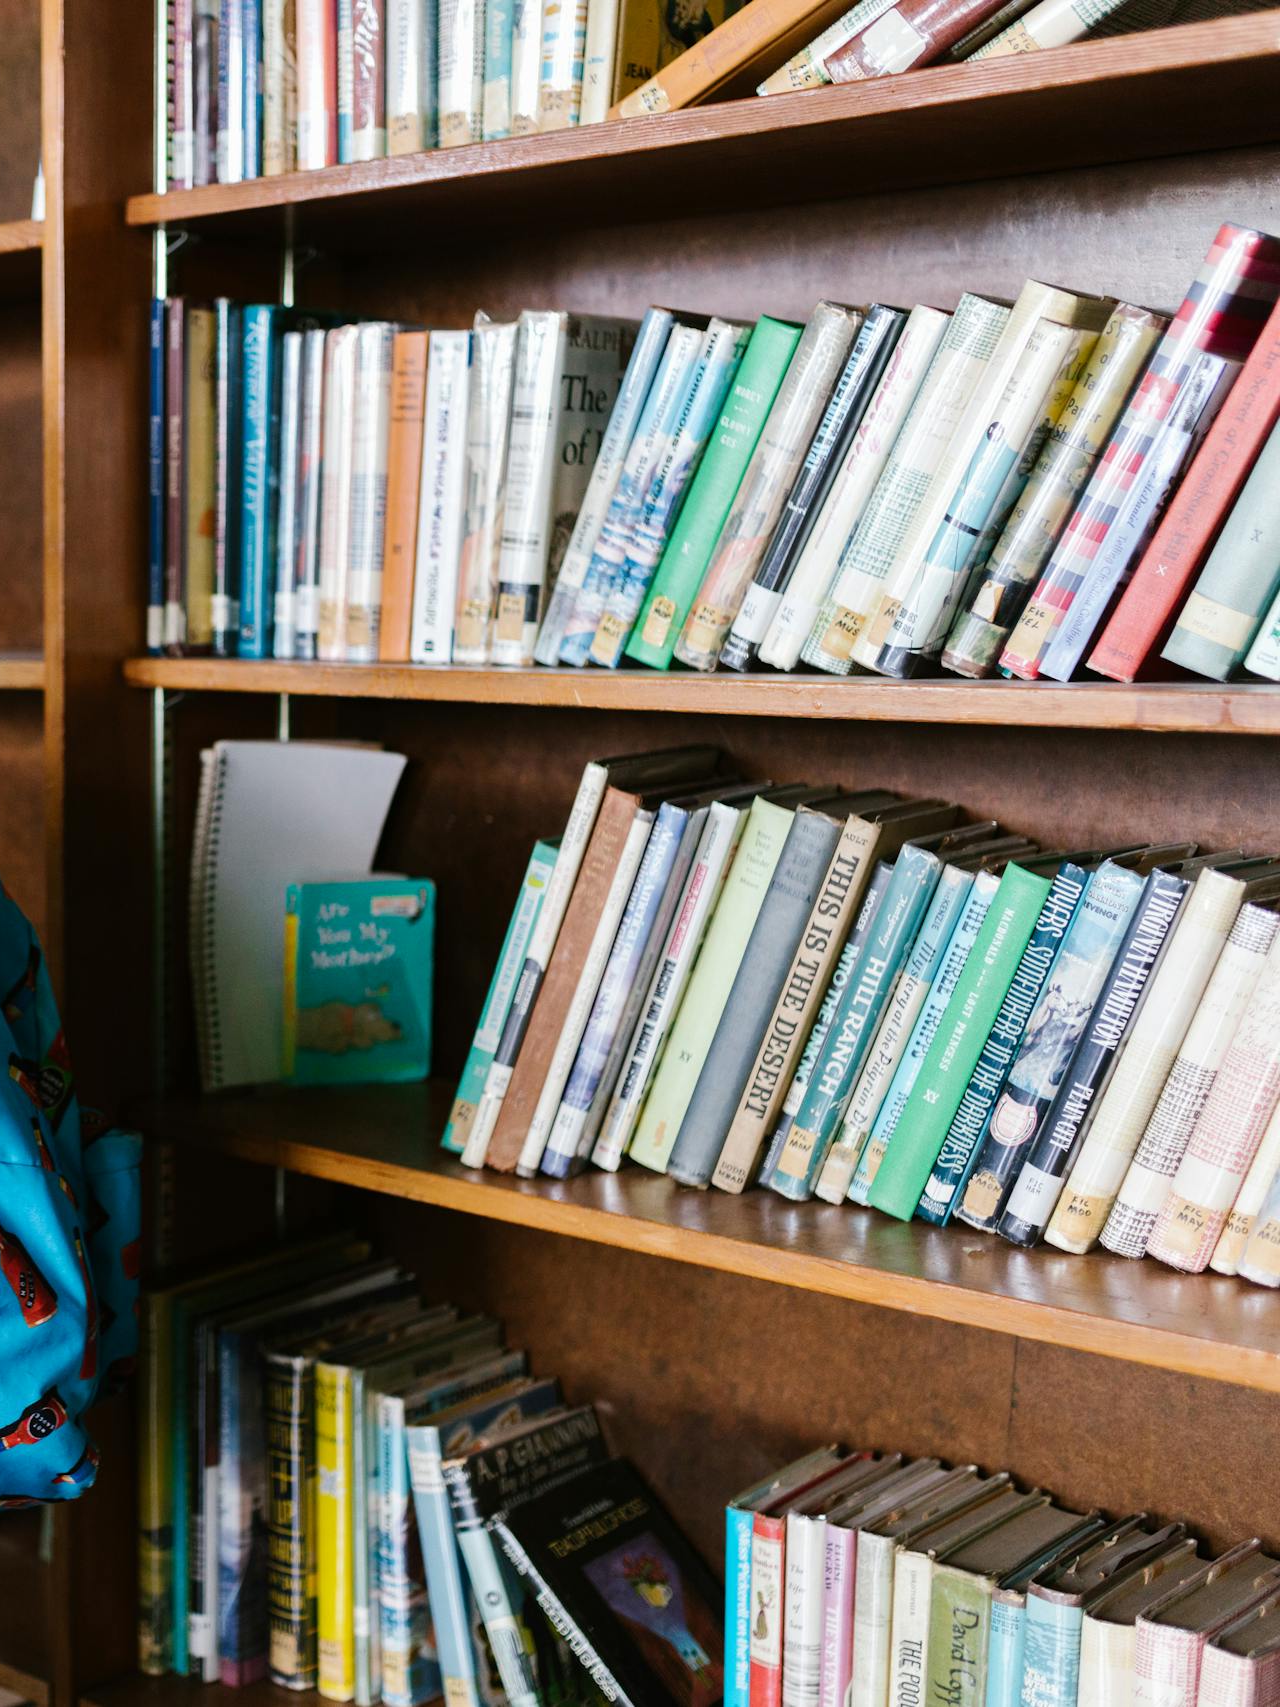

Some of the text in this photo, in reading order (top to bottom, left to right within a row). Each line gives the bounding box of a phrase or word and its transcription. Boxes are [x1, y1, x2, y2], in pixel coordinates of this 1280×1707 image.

[626, 63, 652, 79] JEAN
[703, 329, 719, 359] THE
[561, 374, 608, 413] The
[1232, 371, 1268, 427] Secret
[562, 429, 591, 466] of
[1221, 426, 1241, 447] of
[1123, 479, 1157, 528] McDaniel
[1161, 529, 1188, 563] Hill
[835, 620, 860, 636] MUS
[844, 612, 858, 626] FIC
[1028, 607, 1045, 618] FIC
[843, 831, 869, 847] AULT
[626, 881, 656, 942] America
[854, 887, 879, 933] MOOSER
[961, 897, 990, 936] THE
[1034, 873, 1083, 940] MYERS
[1126, 882, 1183, 968] VIRGINIA
[742, 851, 859, 1121] THIS IS THE DESERT
[935, 939, 973, 998] THREE
[936, 905, 1015, 1073] MACDONALD LOST PRINCESS
[791, 941, 860, 1086] INTO THE UNKNO
[816, 955, 886, 1097] HILL RANCH
[1089, 959, 1149, 1052] HAMILTON
[848, 939, 938, 1131] Mystery at the Pilgrim Di
[934, 937, 1056, 1176] SOMEWHERE IN THE DARKNESS
[1048, 1080, 1094, 1153] PLAIN CITY
[1029, 1177, 1044, 1189] FIC
[1073, 1196, 1089, 1207] FIC
[1177, 1212, 1204, 1232] MAY
[1183, 1205, 1202, 1217] FIC
[1230, 1213, 1248, 1224] FIC
[822, 1606, 837, 1706] THE SEVENT
[897, 1639, 923, 1669] THE
[933, 1607, 979, 1707] David Copp
